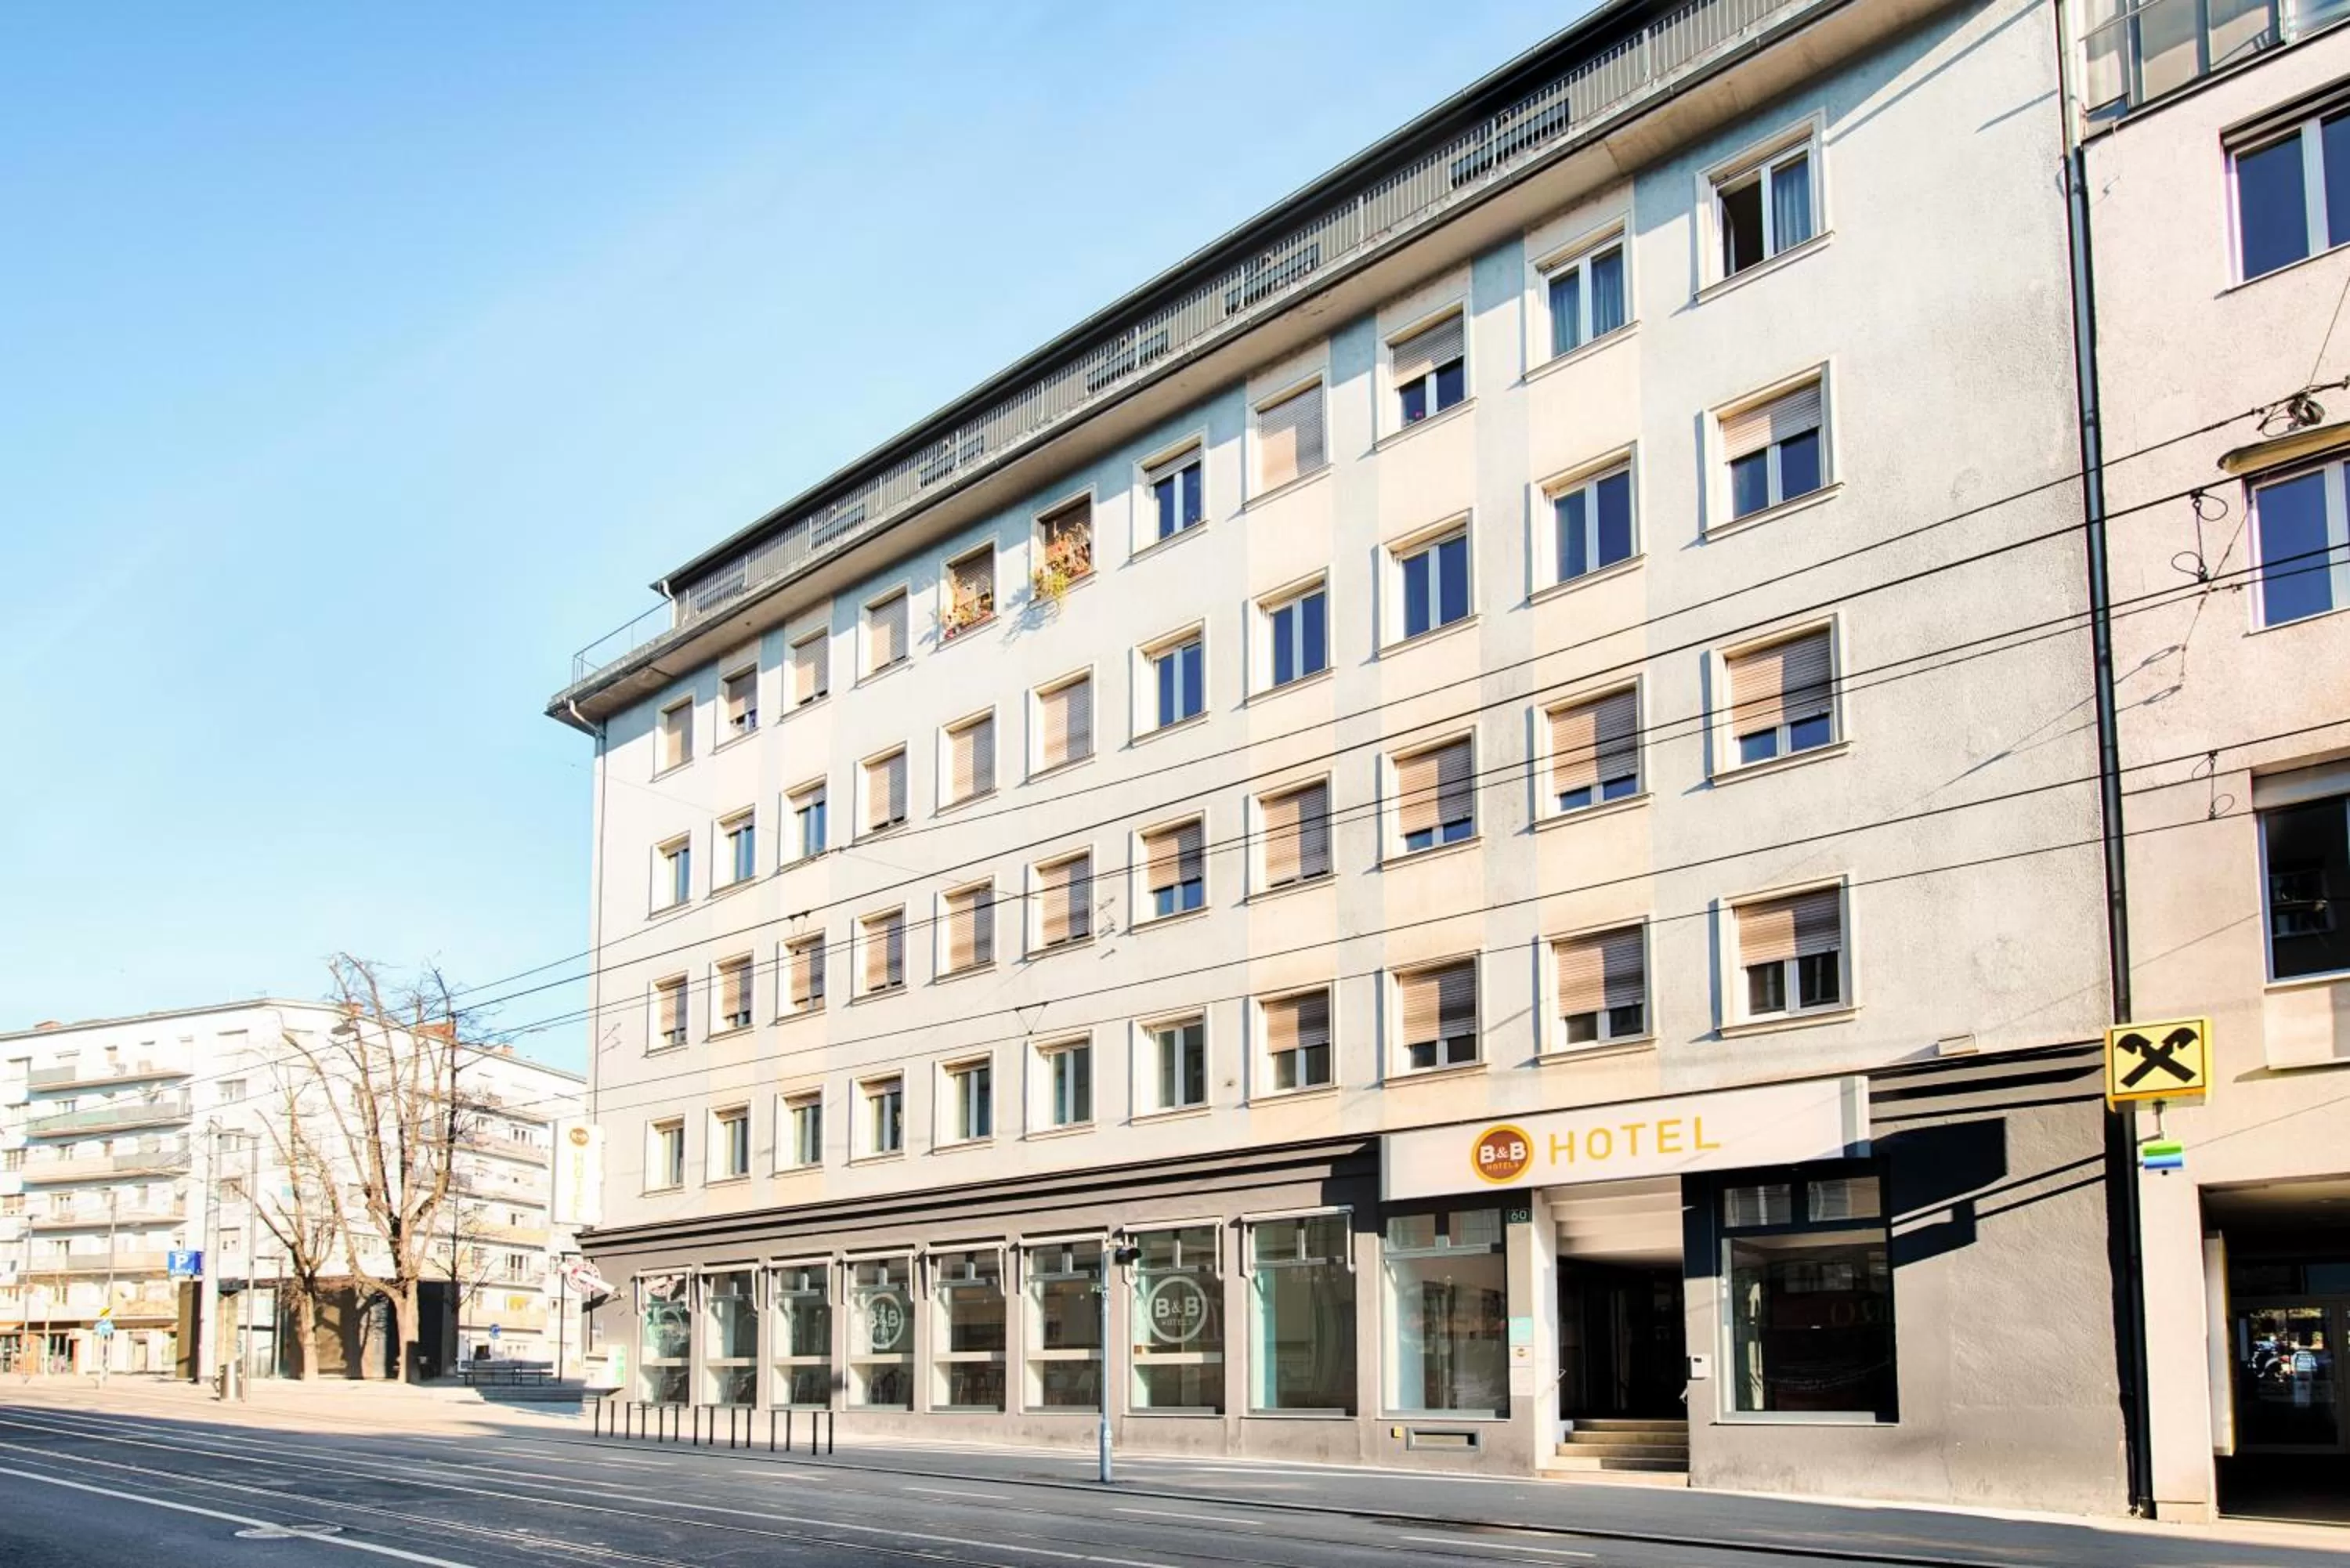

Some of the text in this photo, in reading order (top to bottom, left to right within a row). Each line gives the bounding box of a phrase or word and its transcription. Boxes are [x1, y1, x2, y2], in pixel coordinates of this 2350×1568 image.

[1549, 1116, 1721, 1165] HOTEL
[1479, 1141, 1527, 1165] B&B
[573, 1151, 584, 1221] HOTEL
[1511, 1210, 1527, 1222] 60
[175, 1254, 189, 1268] P
[1155, 1296, 1200, 1318] B&B
